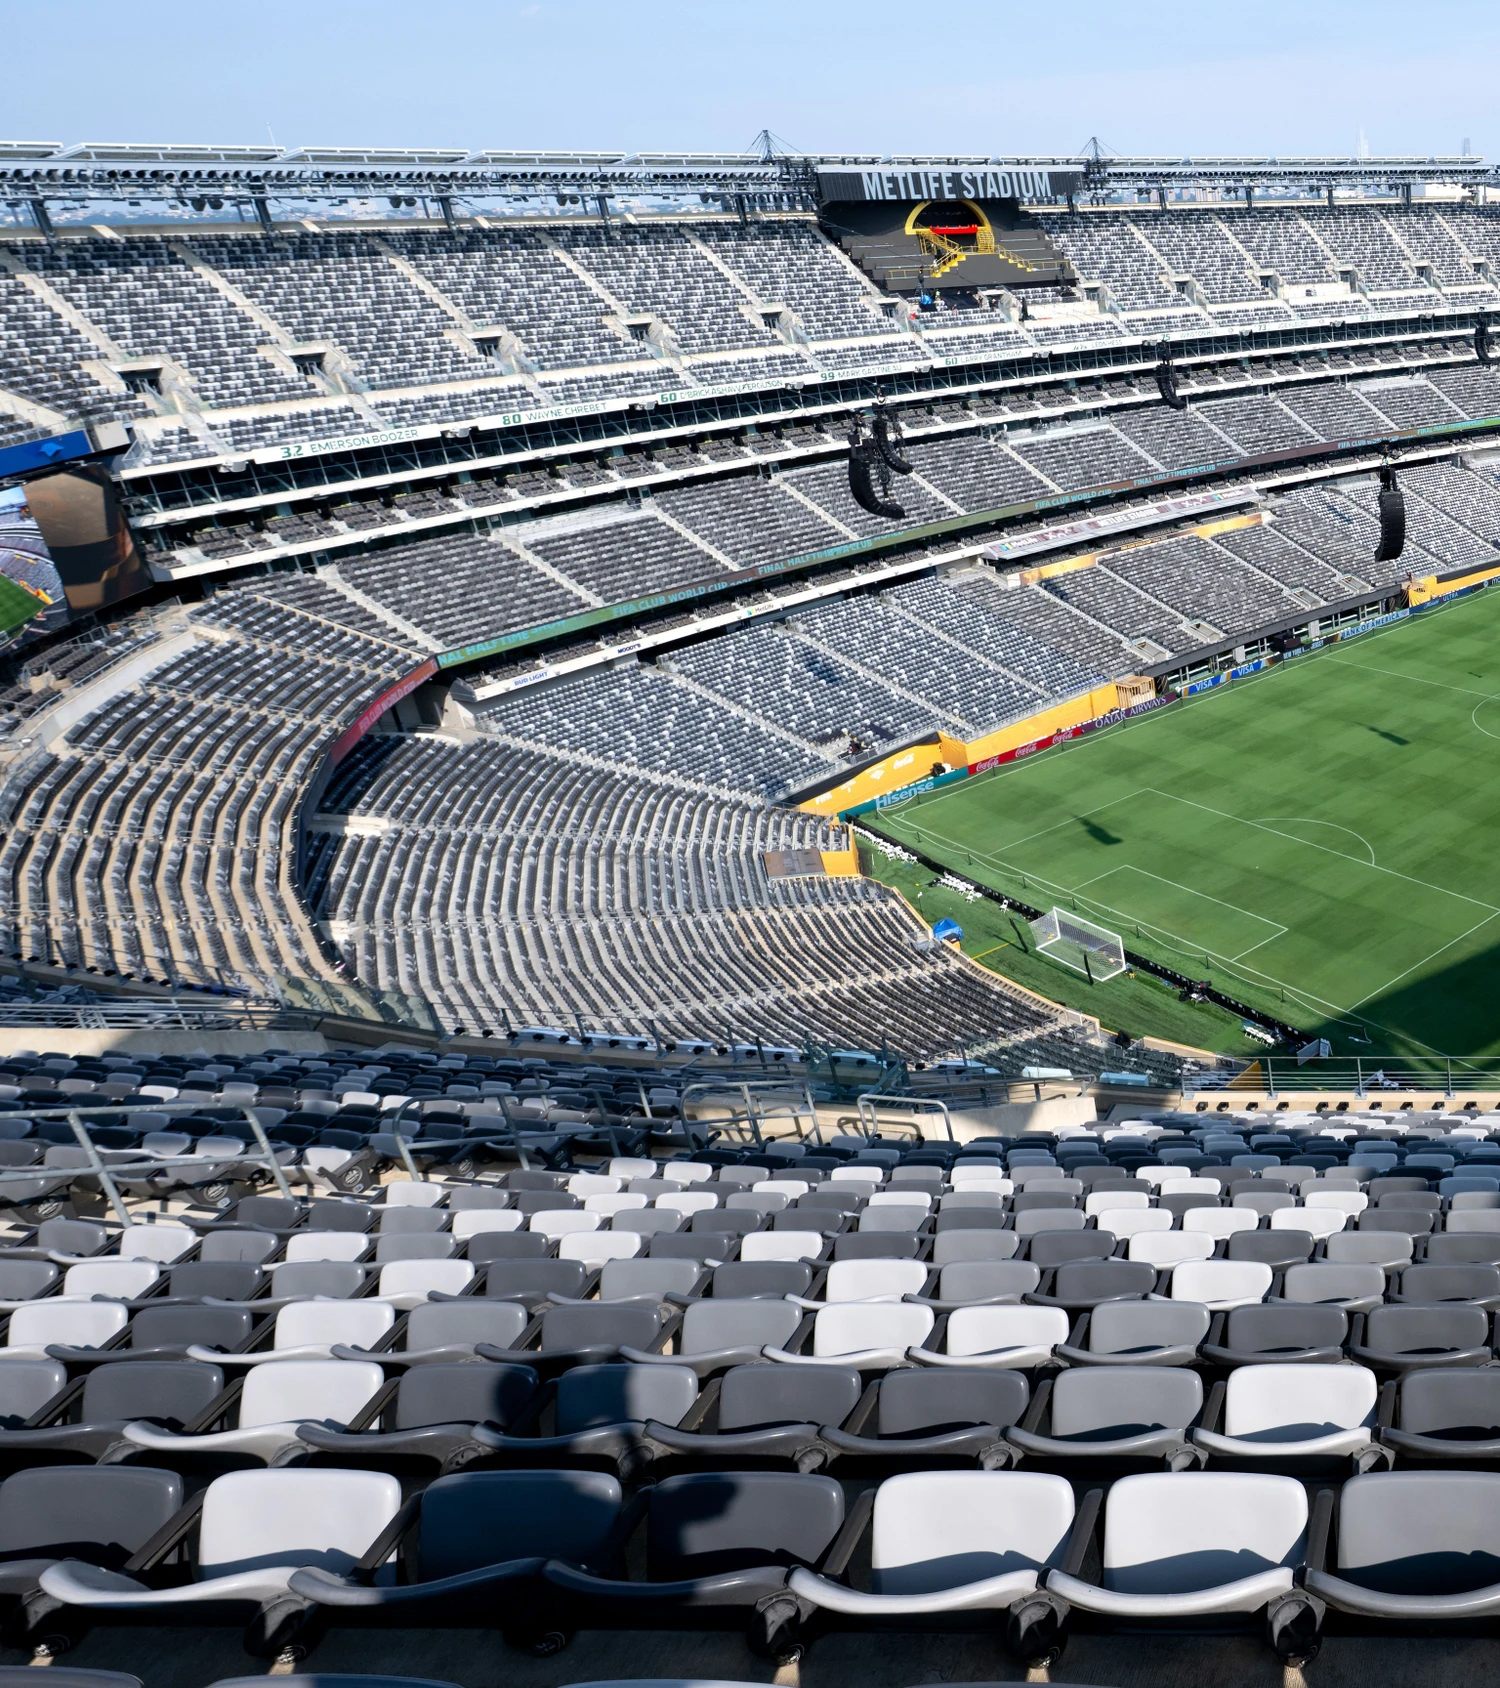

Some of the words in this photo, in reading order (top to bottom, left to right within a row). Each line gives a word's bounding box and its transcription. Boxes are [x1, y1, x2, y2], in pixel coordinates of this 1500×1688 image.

[861, 172, 957, 200] METLIFE
[961, 171, 1052, 199] STADIUM
[1180, 331, 1205, 339] WINSTON
[961, 354, 983, 364] LARRY
[983, 351, 1023, 361] GRANTHAM
[820, 372, 835, 381] 99
[837, 368, 861, 379] MARK
[862, 365, 902, 376] GASTINEAU
[661, 392, 677, 402] 60
[742, 380, 783, 391] FERGUSON
[503, 413, 522, 426] 80
[526, 408, 563, 421] WAYNE
[564, 402, 607, 418] CHREBET
[281, 445, 304, 459] 32
[310, 438, 371, 453] EMERSON
[372, 429, 419, 444] BOOZER
[1338, 441, 1351, 449] FIFA
[1352, 439, 1366, 447] CLUB
[1133, 477, 1153, 487] FINAL
[1034, 500, 1050, 510] FIFA
[1051, 496, 1070, 506] CLUB
[1071, 490, 1097, 502] WORLD
[1098, 488, 1112, 497] CUP
[1098, 513, 1129, 526] METLIFE
[1128, 507, 1160, 521] STADIUM
[1010, 536, 1038, 548] MetLife
[757, 562, 786, 576] FINAL
[611, 604, 637, 617] FIFA
[638, 596, 666, 611] CLUB
[668, 586, 706, 604] WORLD
[707, 581, 728, 593] CUP
[1442, 592, 1459, 602] ULTRA
[754, 603, 774, 613] MetLife
[1341, 627, 1360, 639] BANK
[1361, 622, 1370, 631] OF
[1370, 612, 1400, 628] AMERICA
[465, 631, 530, 656] HALFTIME
[617, 643, 641, 654] MOODY'S
[1238, 664, 1255, 676] VISA
[514, 677, 529, 687] BUD
[529, 671, 548, 682] LIGHT
[1195, 680, 1213, 692] VISA
[382, 687, 403, 711] WORLD
[1095, 710, 1127, 728] QATAR
[1129, 696, 1167, 716] AIRWAYS
[1052, 729, 1073, 744] Coca-Cola
[1014, 742, 1037, 757] Coca-Cola
[975, 756, 999, 772] Coca-Cola
[876, 781, 935, 810] Hisense
